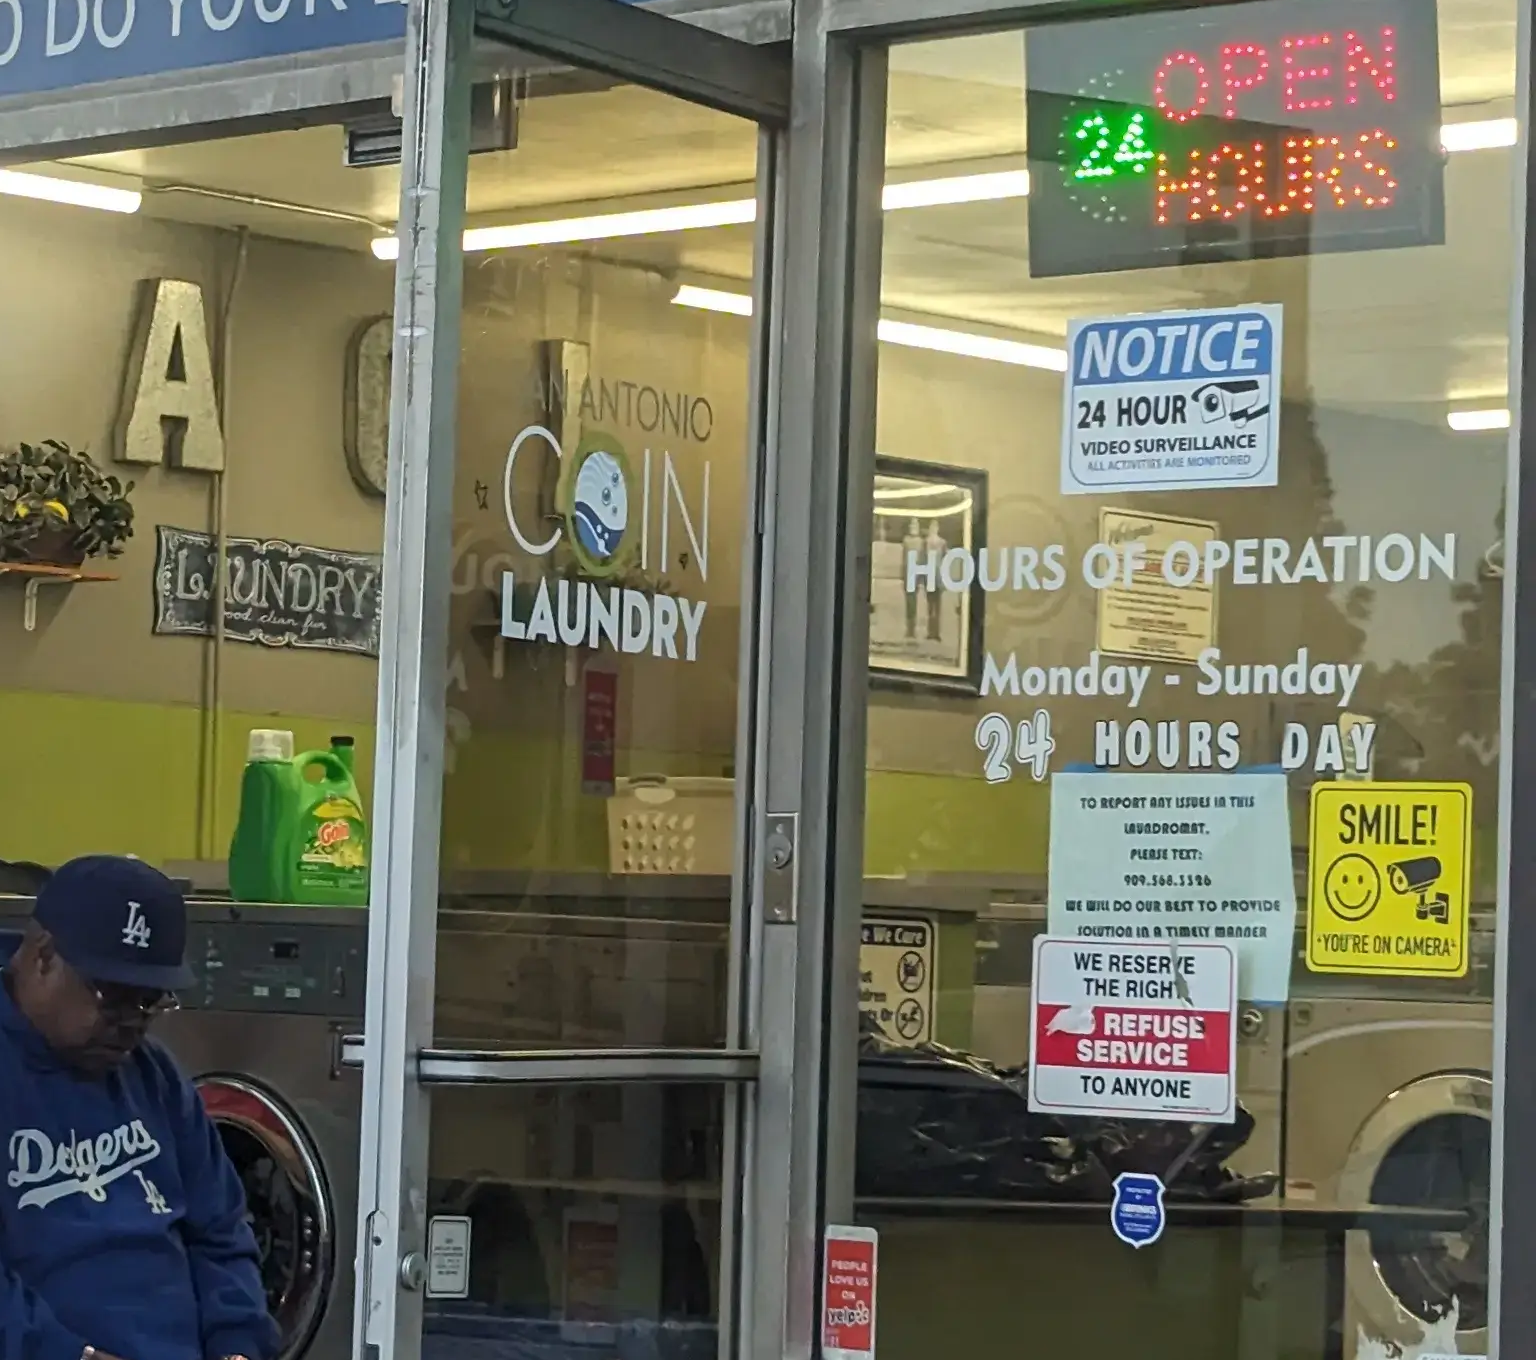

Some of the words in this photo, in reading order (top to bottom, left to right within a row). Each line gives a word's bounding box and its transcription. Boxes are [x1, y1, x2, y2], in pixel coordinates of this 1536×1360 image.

[1150, 22, 1401, 125] OPEN
[1070, 110, 1157, 183] 24
[1153, 126, 1402, 228] HOURS
[1078, 319, 1263, 380] NOTICE
[577, 371, 713, 443] ANTONIO
[1076, 399, 1107, 430] 24
[1116, 393, 1187, 429] HOUR
[1080, 440, 1131, 457] VIDEO
[1133, 433, 1258, 454] SURVEILLANCE
[504, 425, 711, 584] COIN
[906, 544, 1066, 594] HOURS
[1081, 542, 1148, 590] OF
[1161, 532, 1458, 586] OPERATION
[500, 570, 708, 662] LAUNDRY
[978, 651, 1153, 708] Monday
[1164, 674, 1181, 687] -
[1195, 647, 1363, 708] Sunday
[974, 707, 1056, 784] 24
[1093, 719, 1242, 770] HOURS
[1280, 721, 1379, 773] DAY
[1080, 797, 1097, 809] TO
[1100, 797, 1146, 809] REPORT
[1149, 796, 1172, 809] ANY
[1175, 796, 1211, 809] ISSUES
[1214, 796, 1226, 808] IN
[1229, 795, 1255, 808] THIS
[1338, 803, 1439, 846] SMILE!
[1130, 848, 1168, 861] PLEASE
[1171, 848, 1203, 861] TEXT:
[1065, 899, 1083, 912] WE
[1086, 899, 1111, 912] WILL
[1113, 900, 1132, 912] DO
[1135, 900, 1163, 913] OUR
[1165, 899, 1195, 913] BEST
[1199, 900, 1218, 913] TO
[1221, 899, 1282, 912] PROVIDE
[121, 900, 152, 949] LA
[1077, 925, 1133, 938] SOLUTION
[1136, 925, 1150, 938] IN
[1153, 925, 1163, 938] A
[1166, 925, 1211, 938] TIMELY
[1214, 925, 1268, 939] MANNER
[1372, 935, 1392, 954] ON
[1073, 951, 1103, 973] WE
[1083, 977, 1120, 998] THE
[1125, 979, 1182, 1000] RIGH
[1103, 1012, 1206, 1040] REFUSE
[1075, 1038, 1189, 1067] SERVICE
[1080, 1074, 1106, 1095] TO
[1111, 1077, 1192, 1099] ANYONE
[8, 1119, 161, 1204] Dodgers
[831, 1259, 868, 1272] PEOPLE
[829, 1274, 855, 1286] LOVE
[855, 1275, 870, 1287] US
[829, 1307, 856, 1325] yelp
